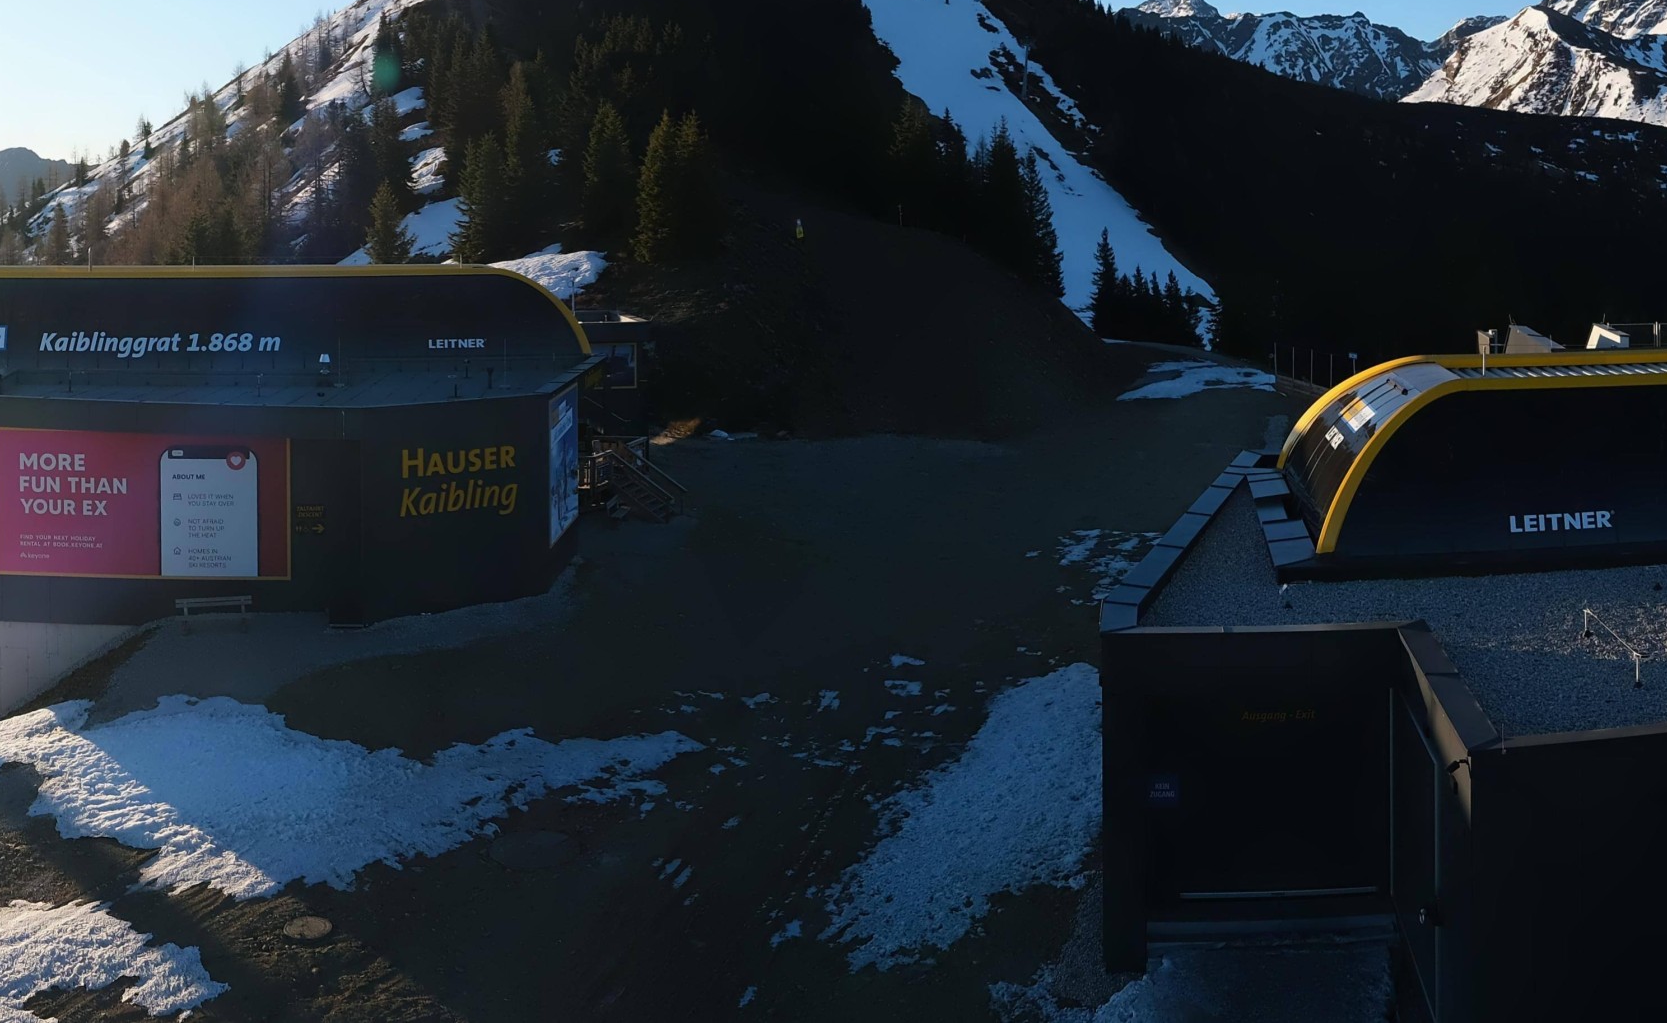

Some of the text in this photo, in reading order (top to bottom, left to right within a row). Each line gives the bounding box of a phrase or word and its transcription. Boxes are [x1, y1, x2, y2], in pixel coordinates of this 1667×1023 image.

[39, 331, 281, 357] Kaiblinggrat 1.868 m
[428, 338, 485, 348] LEITNER
[19, 452, 86, 471] MORE
[401, 445, 516, 479] HAUSER
[19, 475, 127, 494] FUN THAN
[20, 498, 108, 516] YOUR EX
[399, 479, 519, 517] Kaibling
[1509, 510, 1612, 533] LEITNER
[1240, 711, 1287, 722] Ausgang
[1295, 708, 1315, 719] Exit
[1149, 790, 1175, 798] ZUGANG
[1154, 782, 1170, 790] KEIN
